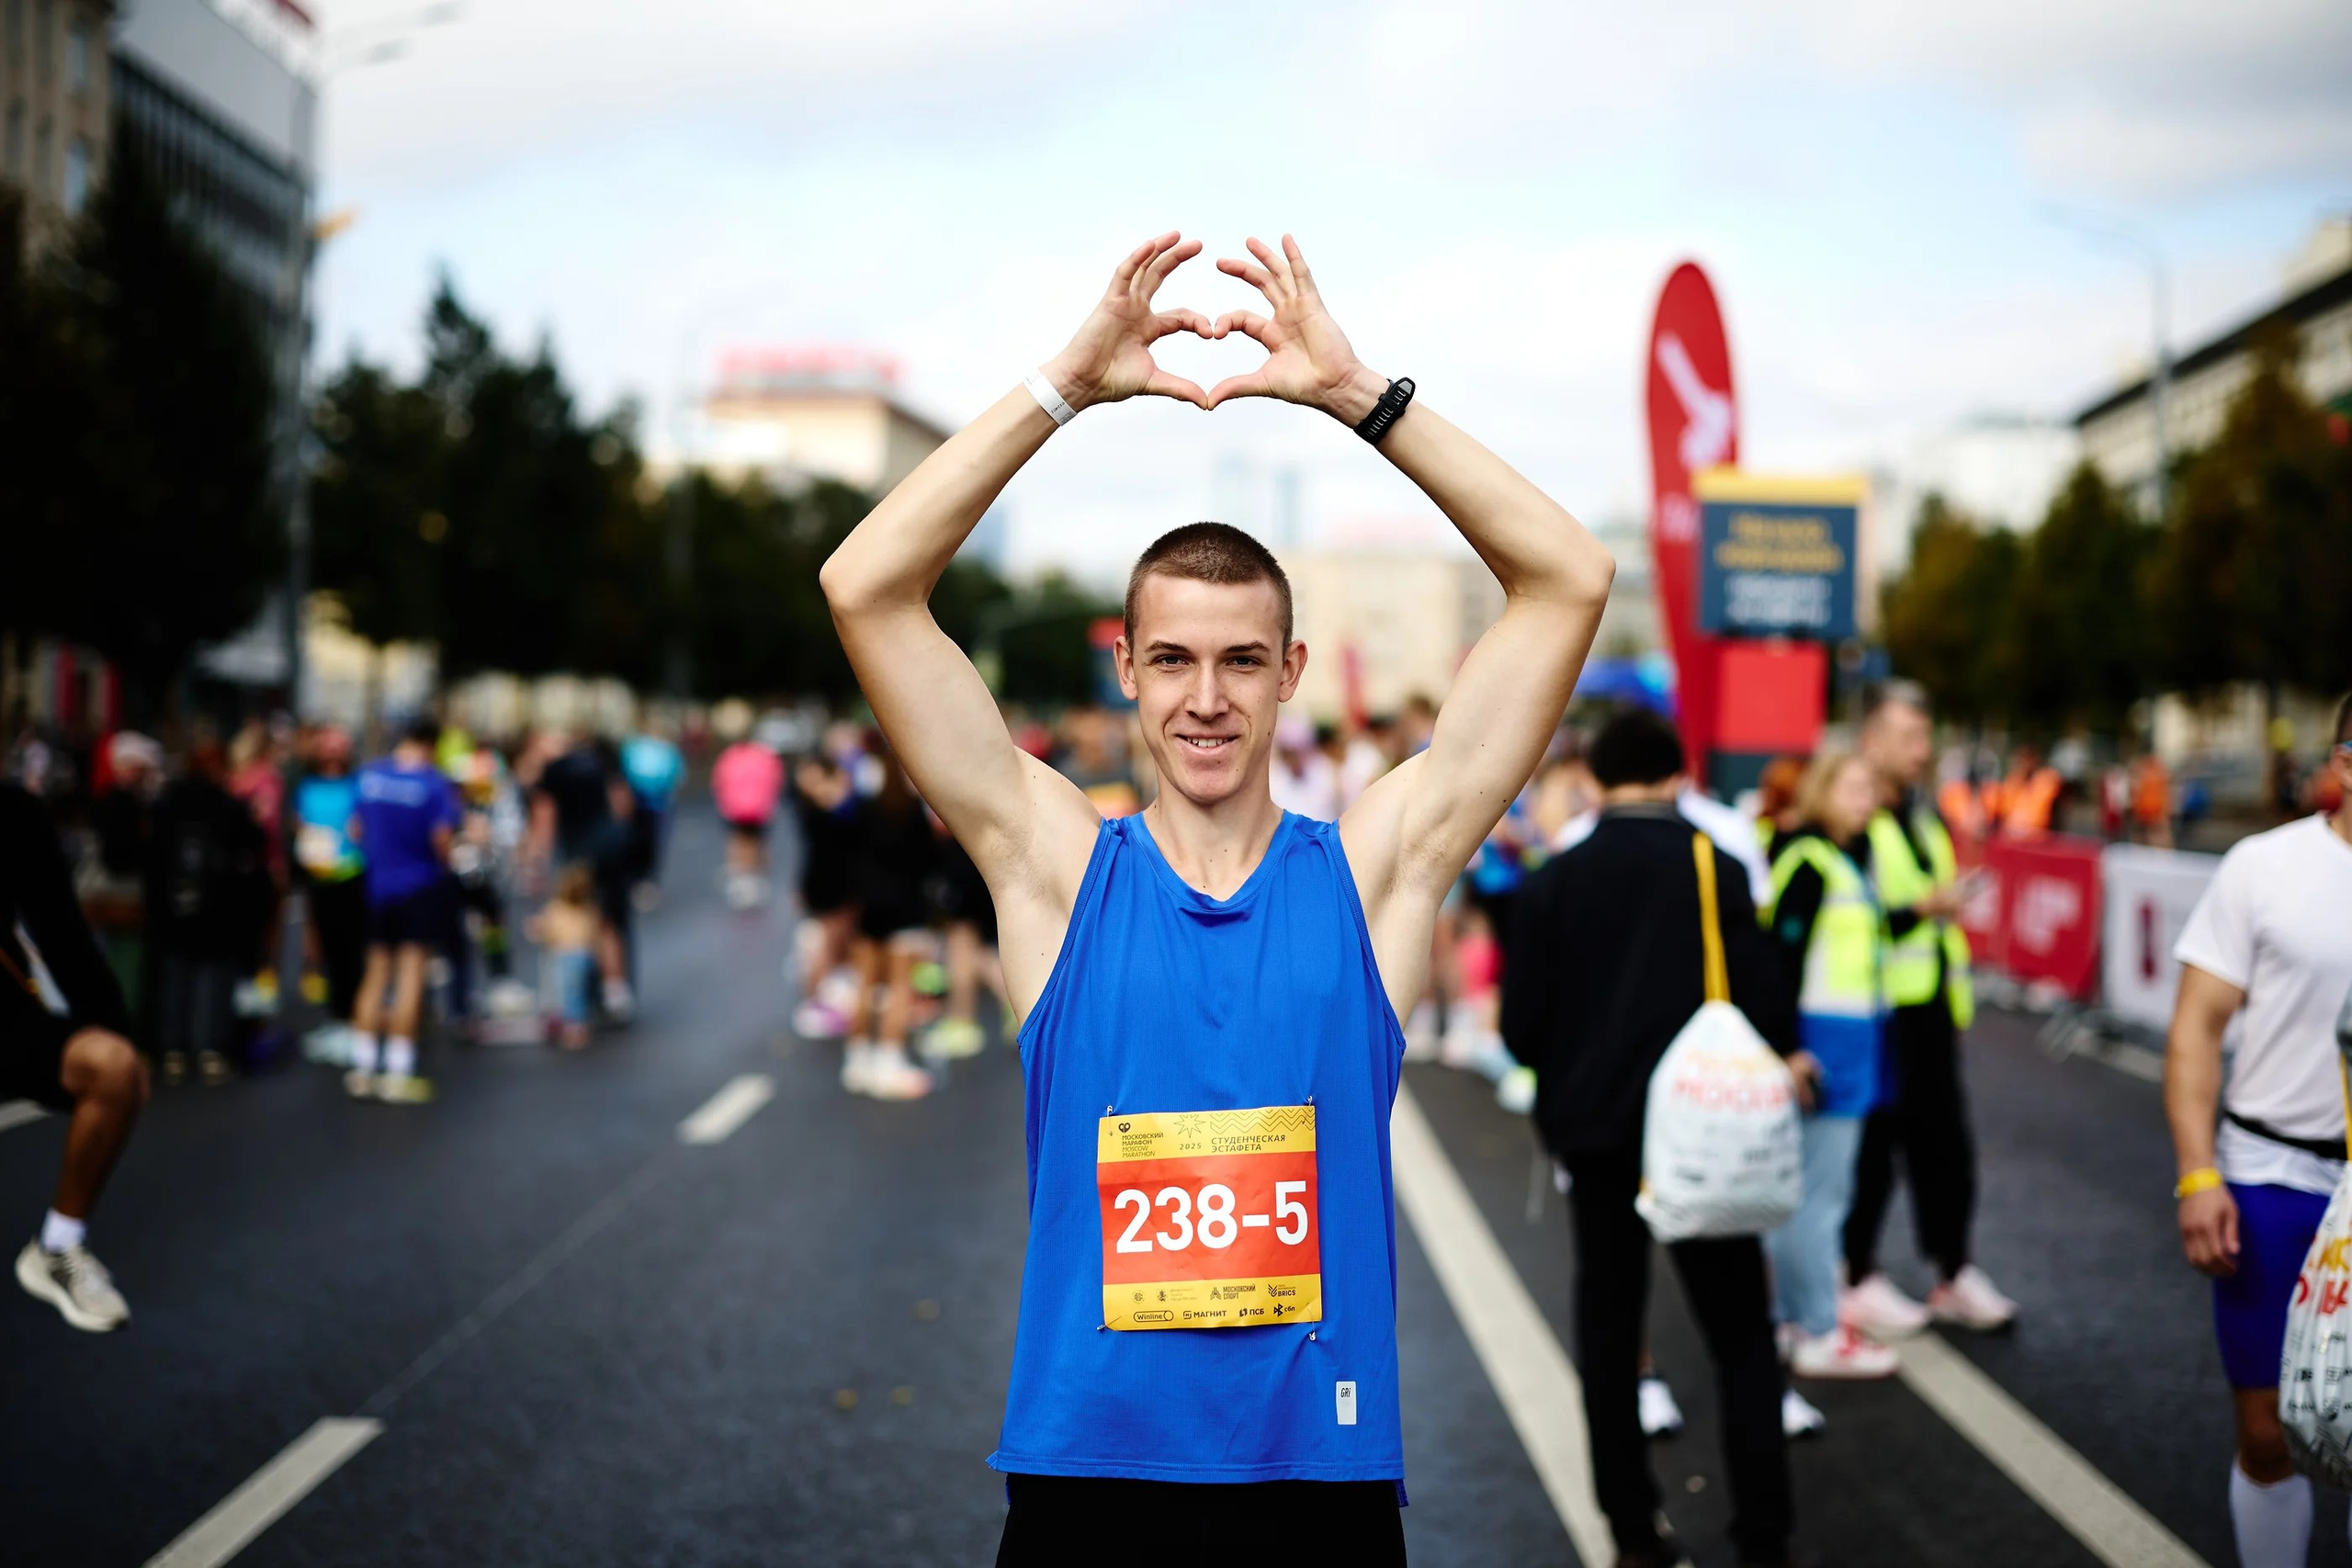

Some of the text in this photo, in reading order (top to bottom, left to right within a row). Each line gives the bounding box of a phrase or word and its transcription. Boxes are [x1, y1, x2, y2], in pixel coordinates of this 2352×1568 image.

[1122, 1132, 1164, 1141] МОСКОВСКИЙ
[1211, 1134, 1286, 1145] СТУДЕНЧЕСКАЯ
[1211, 1144, 1262, 1153] ЭСТАФЕТА
[1114, 1180, 1308, 1254] 238-5
[1223, 1284, 1256, 1293] МОСКОВСКИЙ
[1193, 1310, 1227, 1318] МАГНИТ
